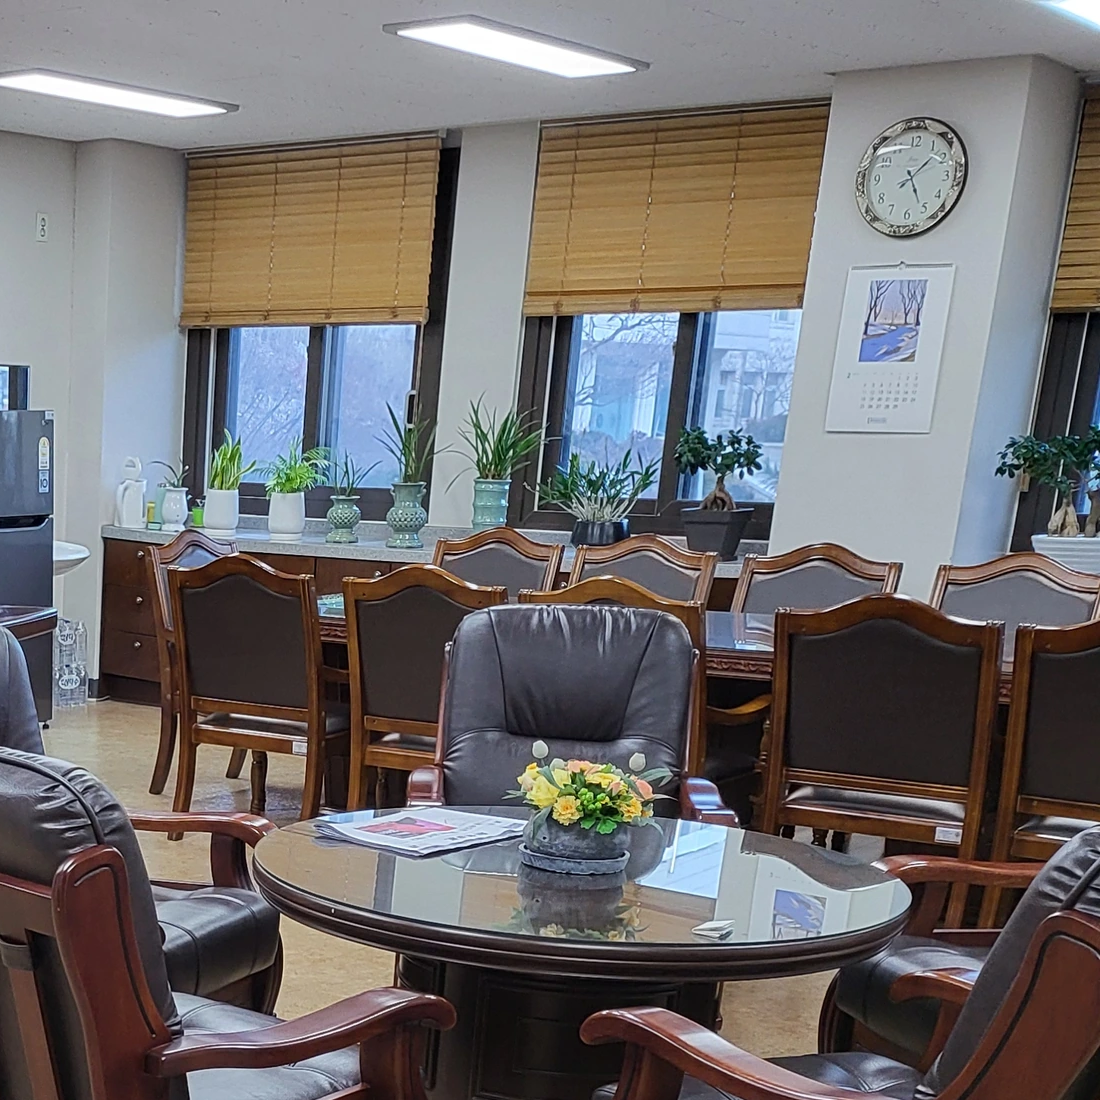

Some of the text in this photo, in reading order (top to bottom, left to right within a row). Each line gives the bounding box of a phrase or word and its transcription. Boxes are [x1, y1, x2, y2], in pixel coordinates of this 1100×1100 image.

[911, 135, 922, 147] 12
[931, 140, 935, 151] 1
[881, 157, 892, 168] 10
[939, 152, 947, 164] 2
[874, 174, 881, 186] 9
[942, 170, 950, 181] 3
[878, 192, 885, 204] 8
[934, 189, 941, 200] 4
[888, 204, 895, 215] 7
[903, 208, 911, 220] 6
[920, 202, 928, 214] 5
